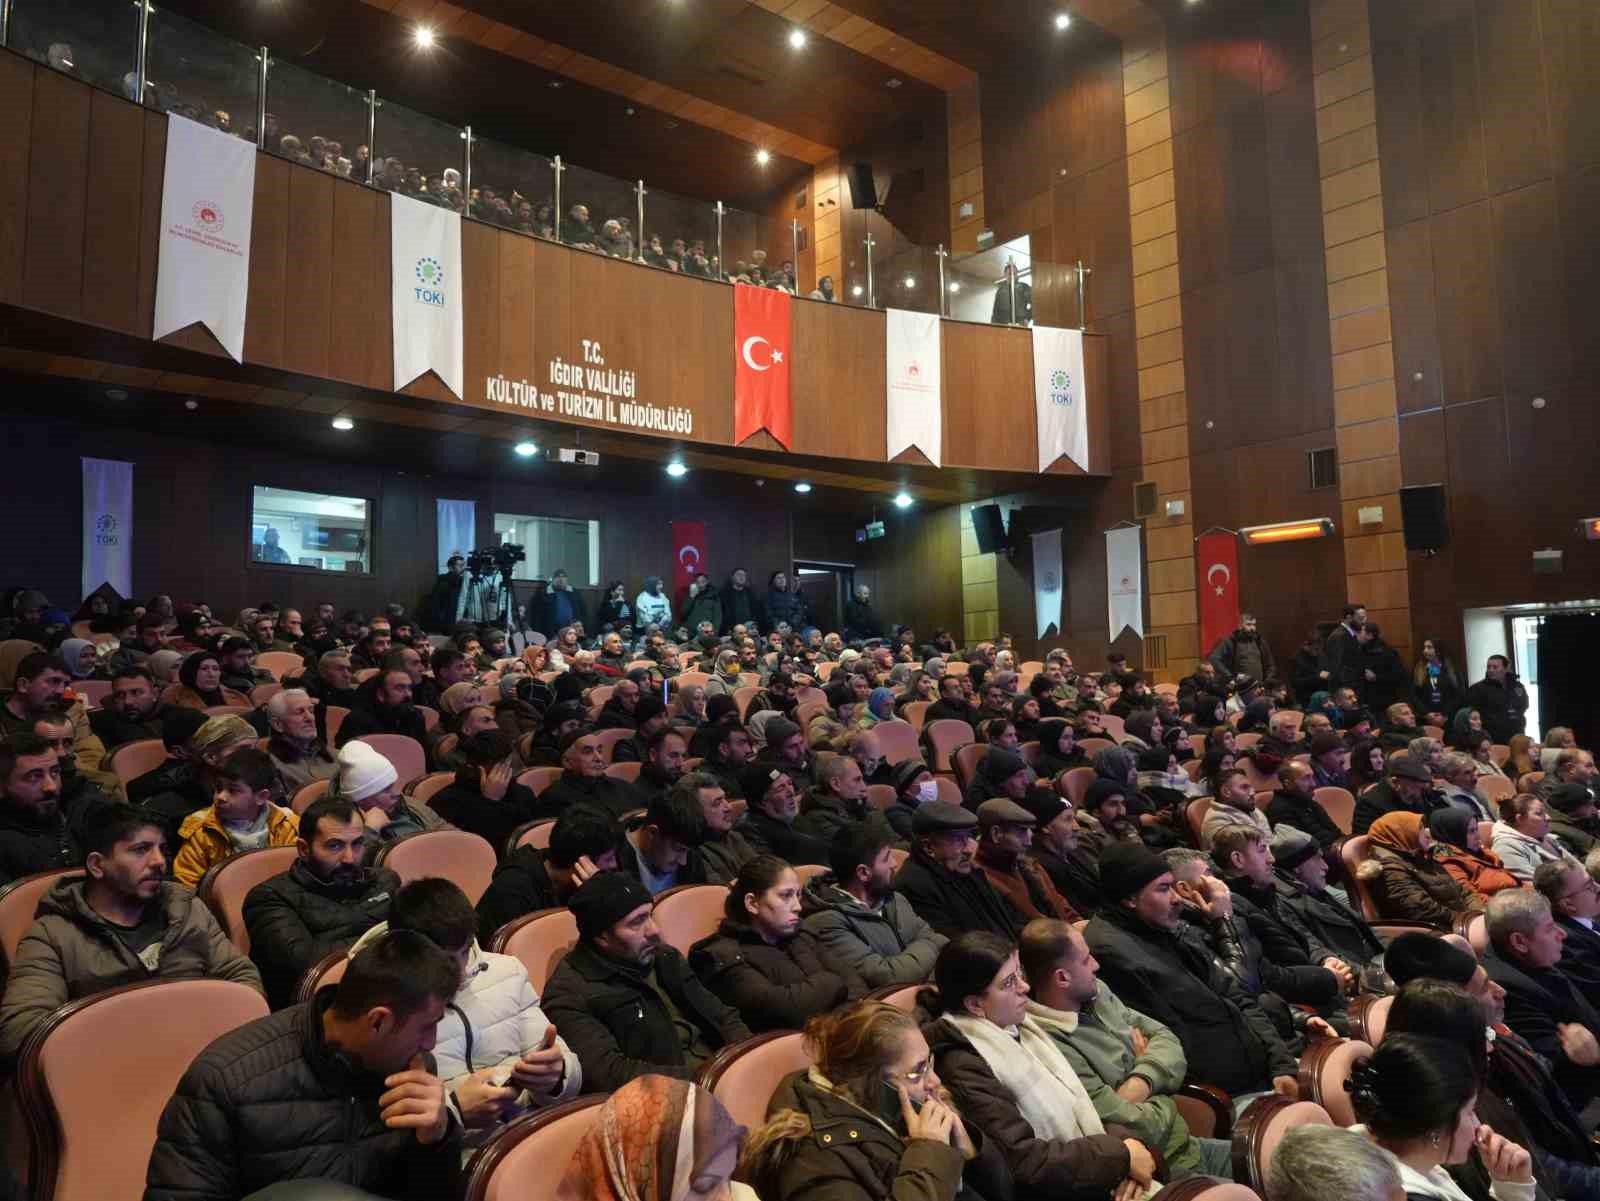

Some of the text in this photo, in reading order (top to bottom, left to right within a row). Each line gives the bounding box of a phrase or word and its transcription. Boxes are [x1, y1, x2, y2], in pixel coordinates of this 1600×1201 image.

[582, 339, 604, 365] T.C.
[550, 357, 635, 398] IĞDIR VALİLİĞİ
[486, 374, 693, 434] KÜLTÜR ve TURİZM İL MÜDÜRLÜĞÜ
